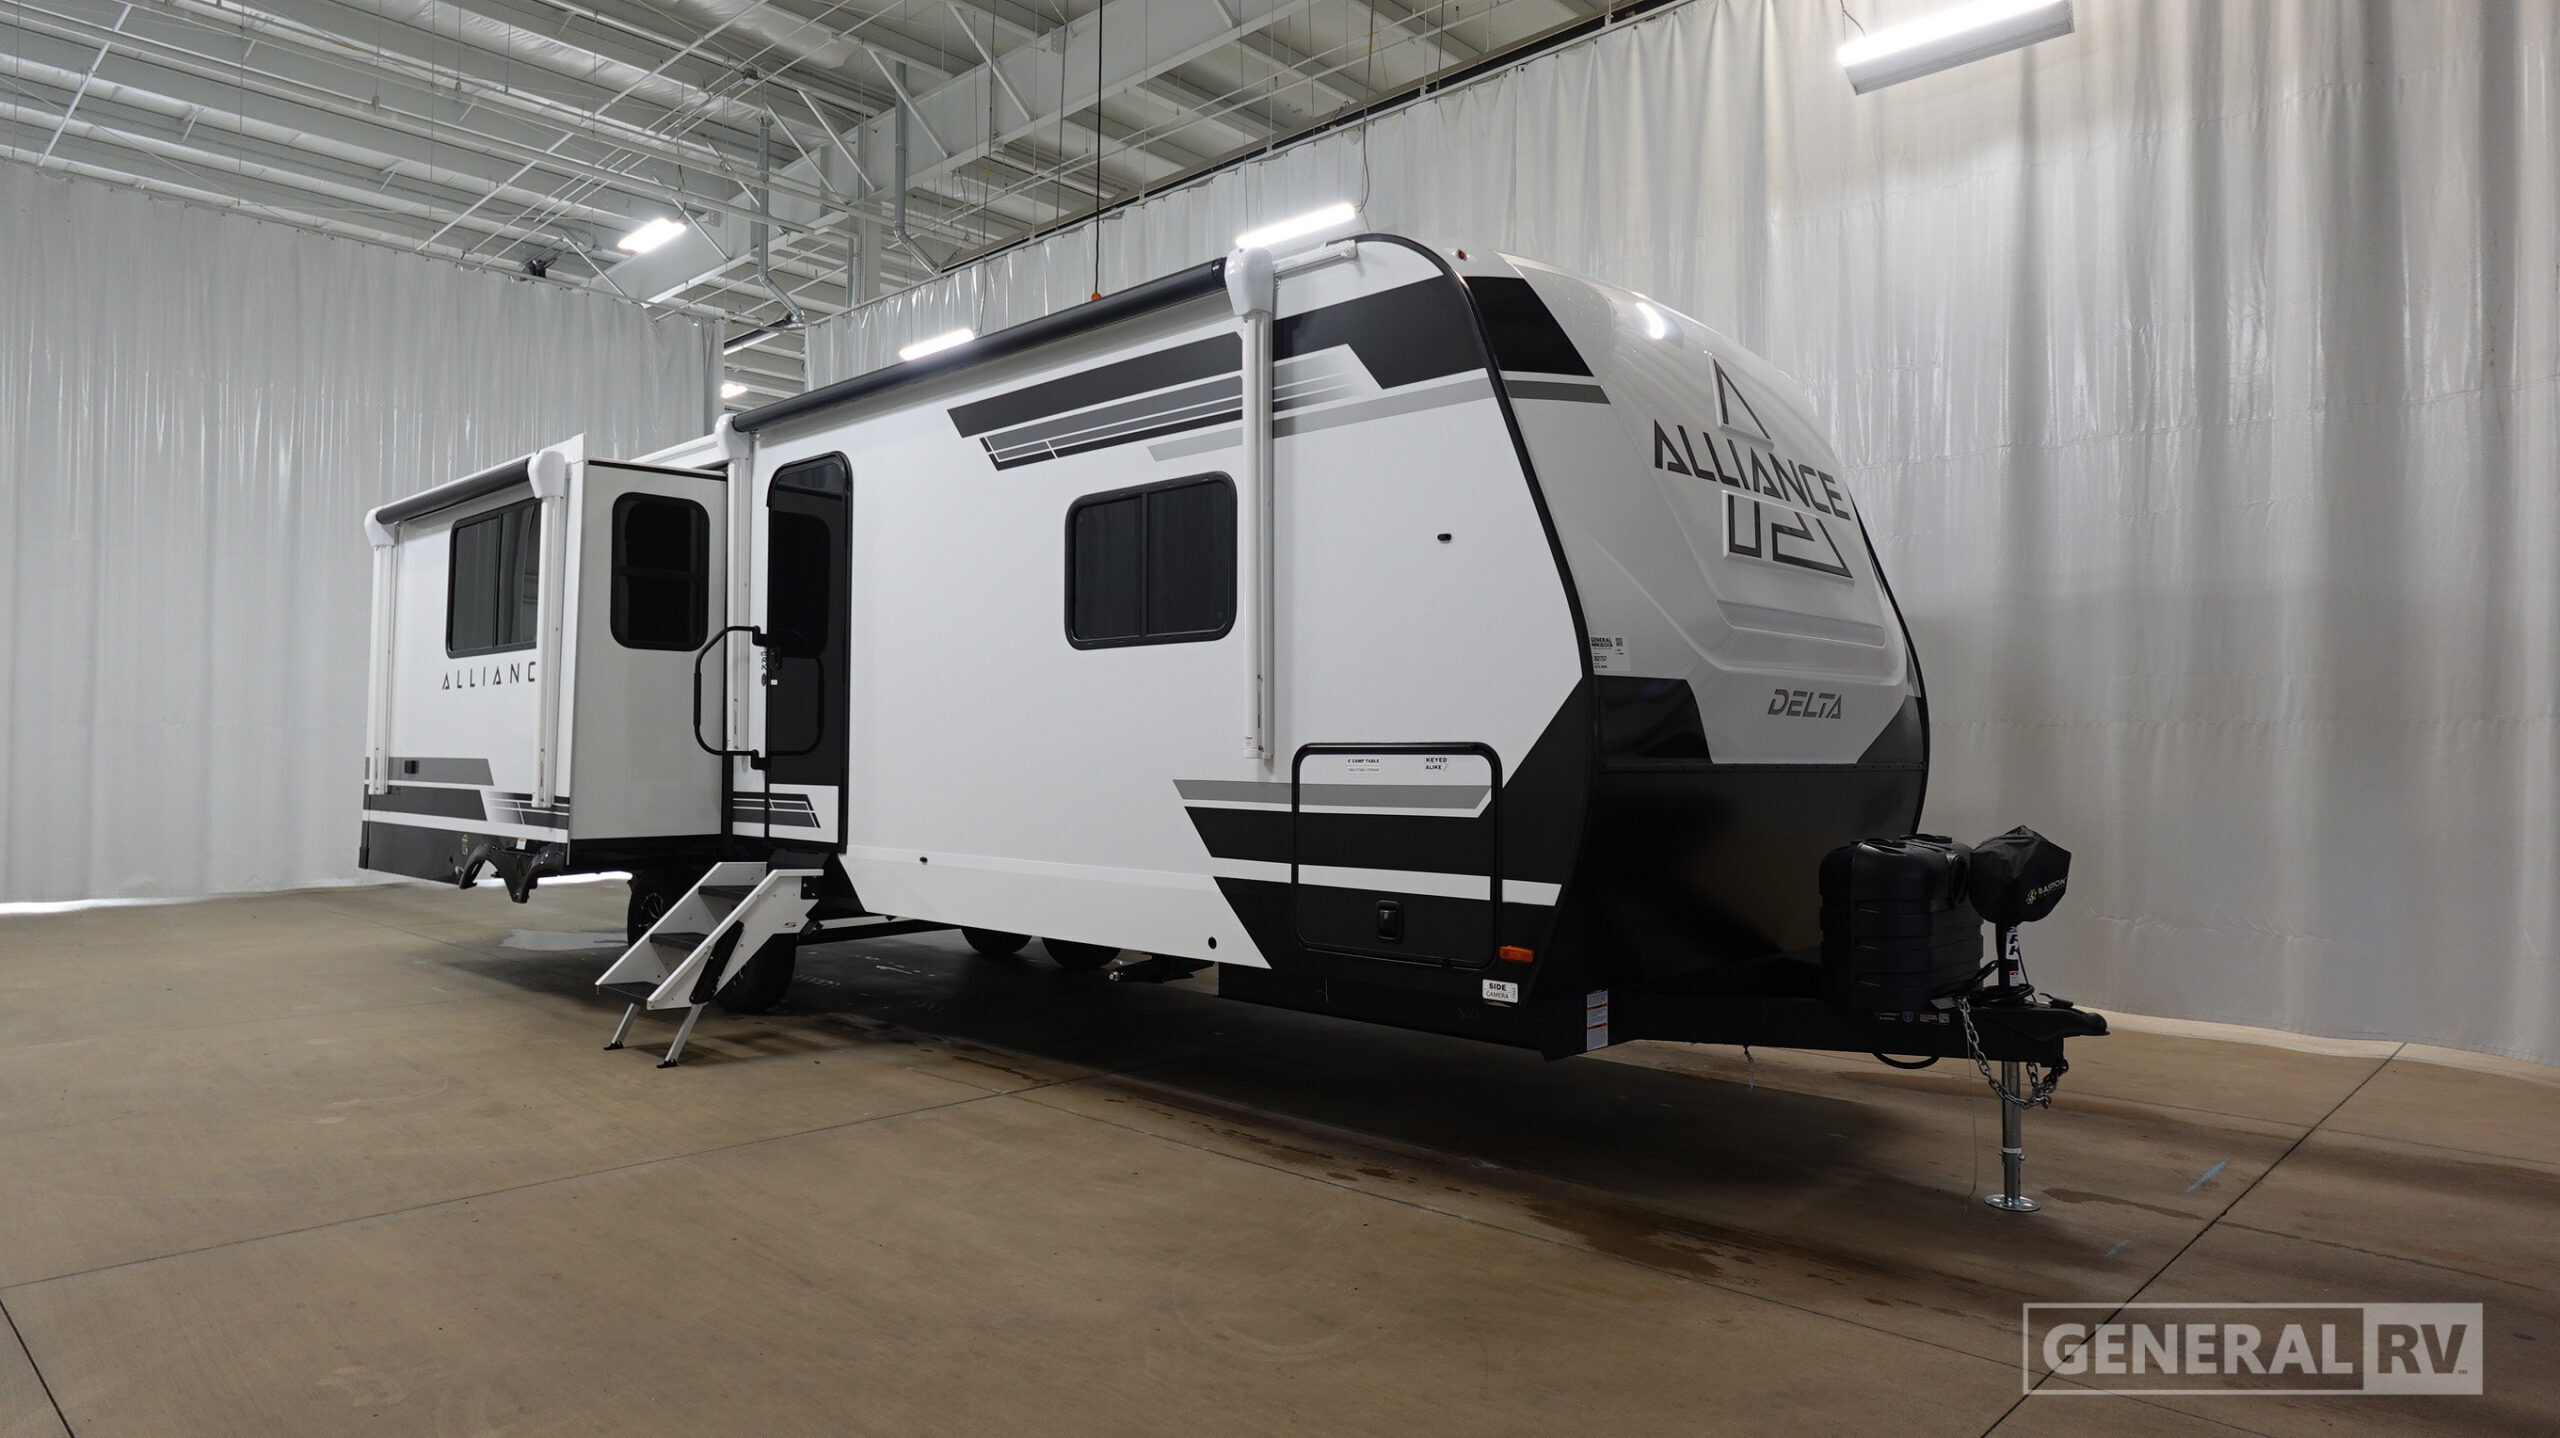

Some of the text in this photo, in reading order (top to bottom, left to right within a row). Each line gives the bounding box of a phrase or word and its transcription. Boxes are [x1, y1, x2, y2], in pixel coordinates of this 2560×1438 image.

[1654, 419, 1851, 521] ALLIANCE
[442, 661, 536, 690] ALLIANC
[1768, 689, 1842, 719] DELTA
[1486, 990, 1509, 999] CAMERA
[1489, 982, 1507, 991] SIDE
